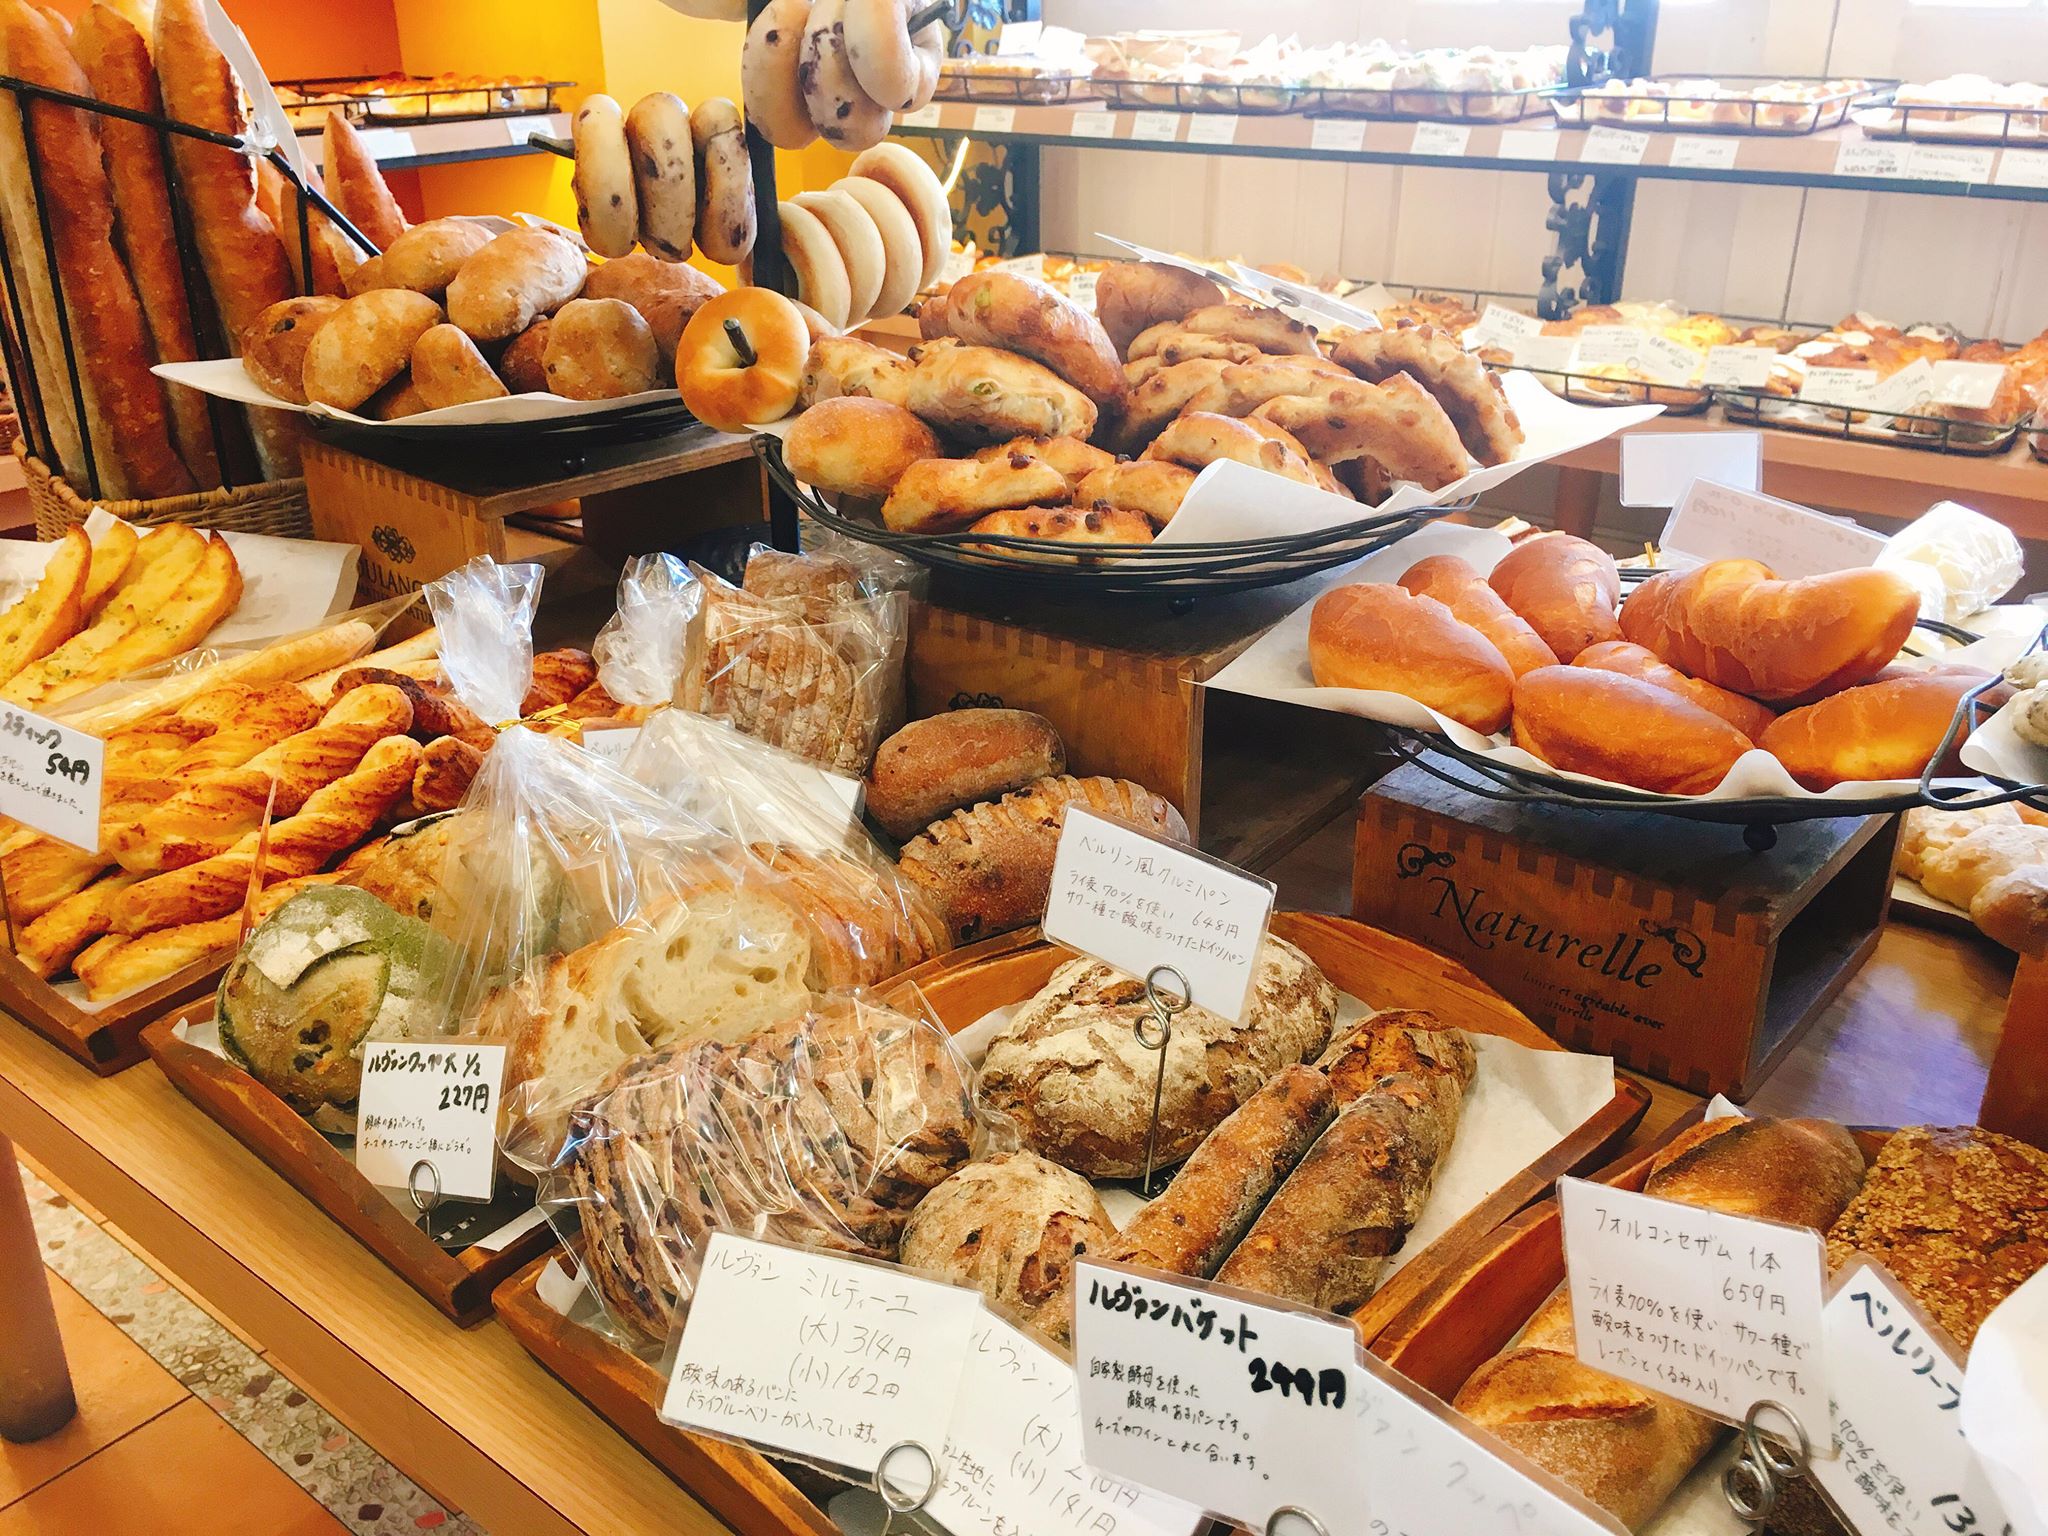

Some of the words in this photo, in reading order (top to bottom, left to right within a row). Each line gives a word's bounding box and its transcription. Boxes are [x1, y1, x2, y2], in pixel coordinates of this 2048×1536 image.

[45, 753, 90, 786] 54円
[1079, 835, 1232, 907] ベルリン風クルミパン
[1191, 911, 1240, 939] 648円
[1427, 875, 1664, 990] Naturelle
[438, 1083, 490, 1114] 227円
[1595, 1207, 1733, 1261] フォルコンセザム
[1749, 1246, 1782, 1274] 1本
[711, 1249, 781, 1281] ルヴァン
[1722, 1276, 1786, 1316] 659円
